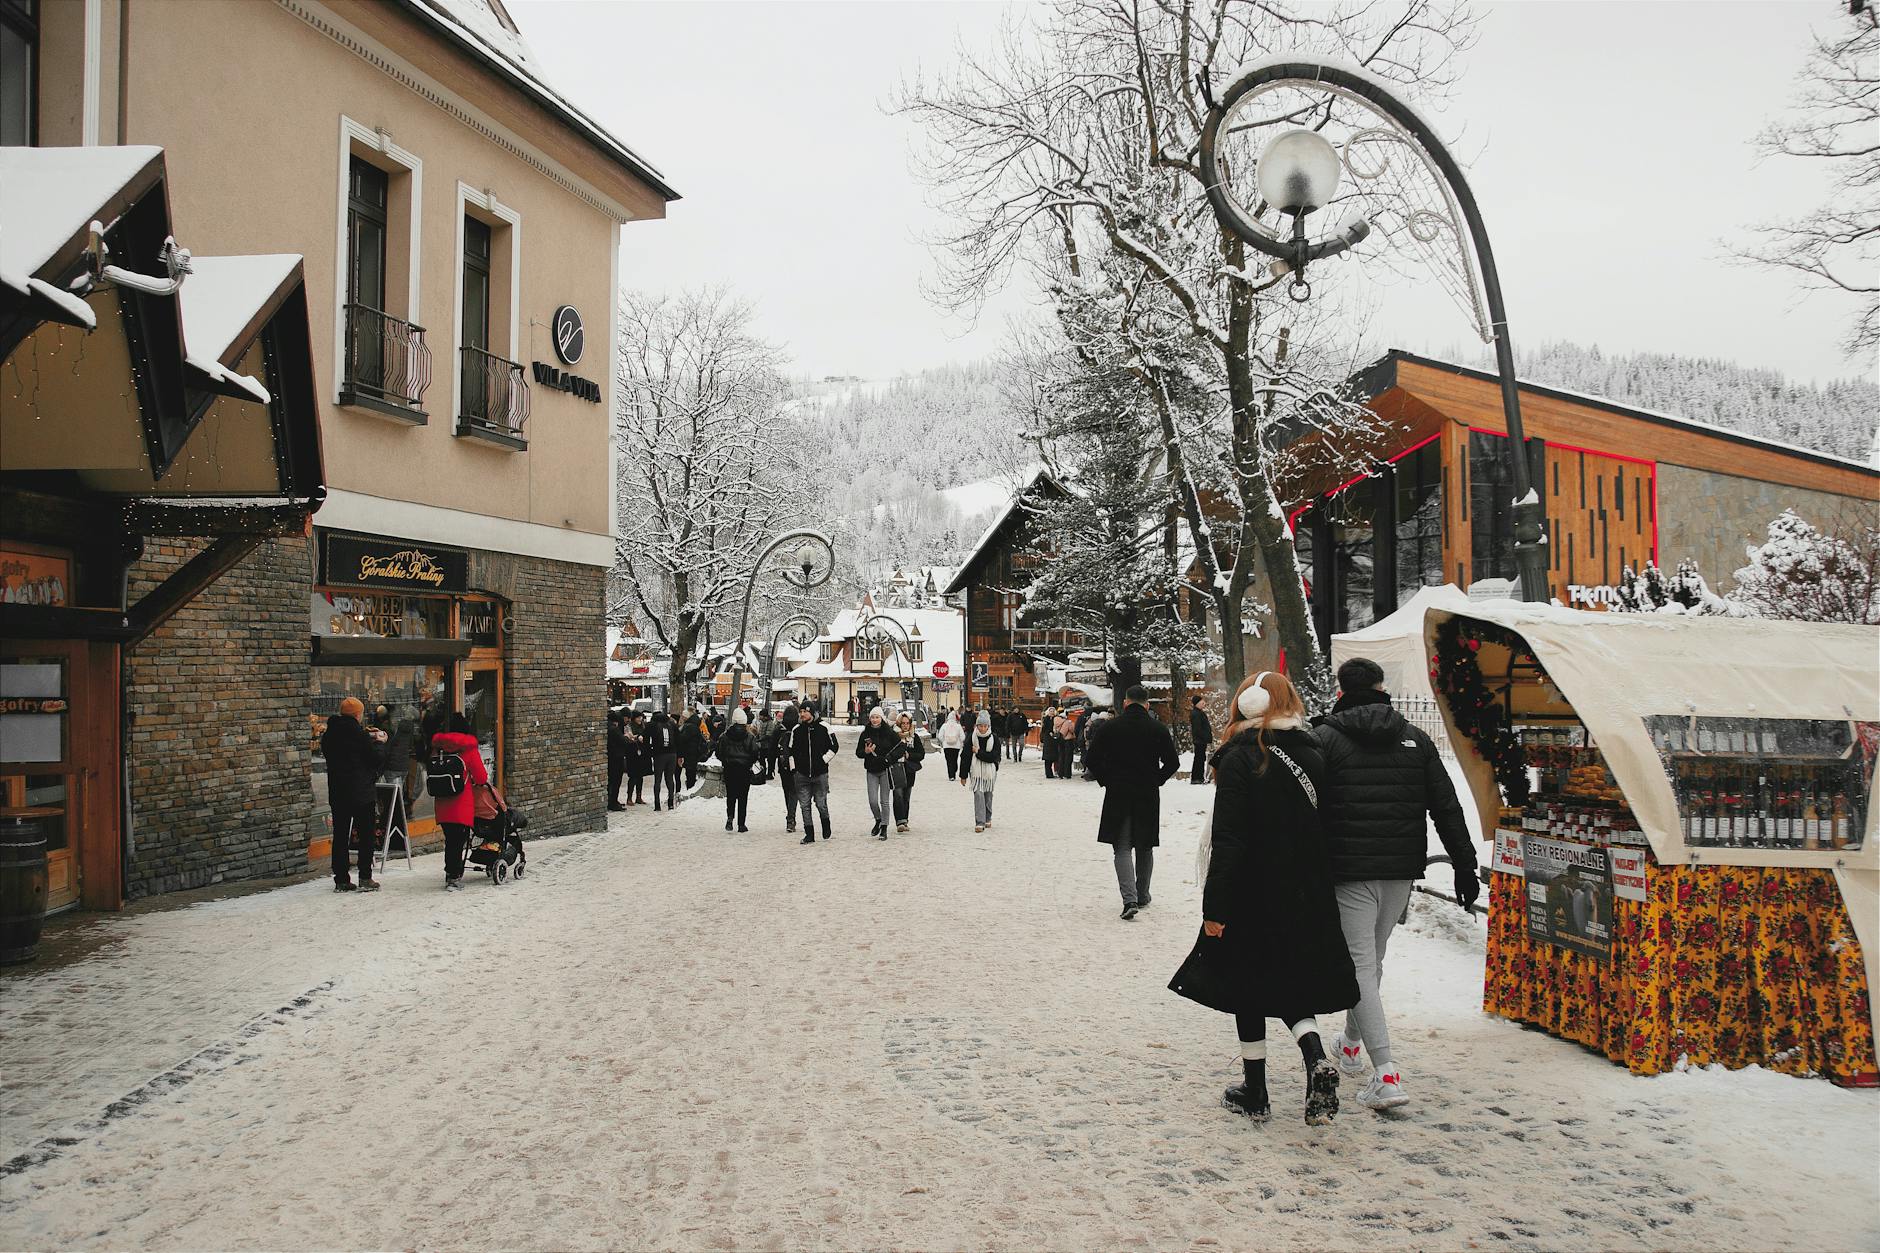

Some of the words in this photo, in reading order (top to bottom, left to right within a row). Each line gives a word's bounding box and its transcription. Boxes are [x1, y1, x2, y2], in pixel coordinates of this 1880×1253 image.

[532, 361, 574, 393] VILLA
[569, 375, 602, 403] VITA
[358, 555, 407, 581] Góralskie
[406, 561, 446, 587] Praliny
[933, 666, 949, 674] STOP
[0, 699, 38, 713] gofry
[1527, 842, 1547, 858] SERY
[1549, 846, 1605, 871] REGIONALNE
